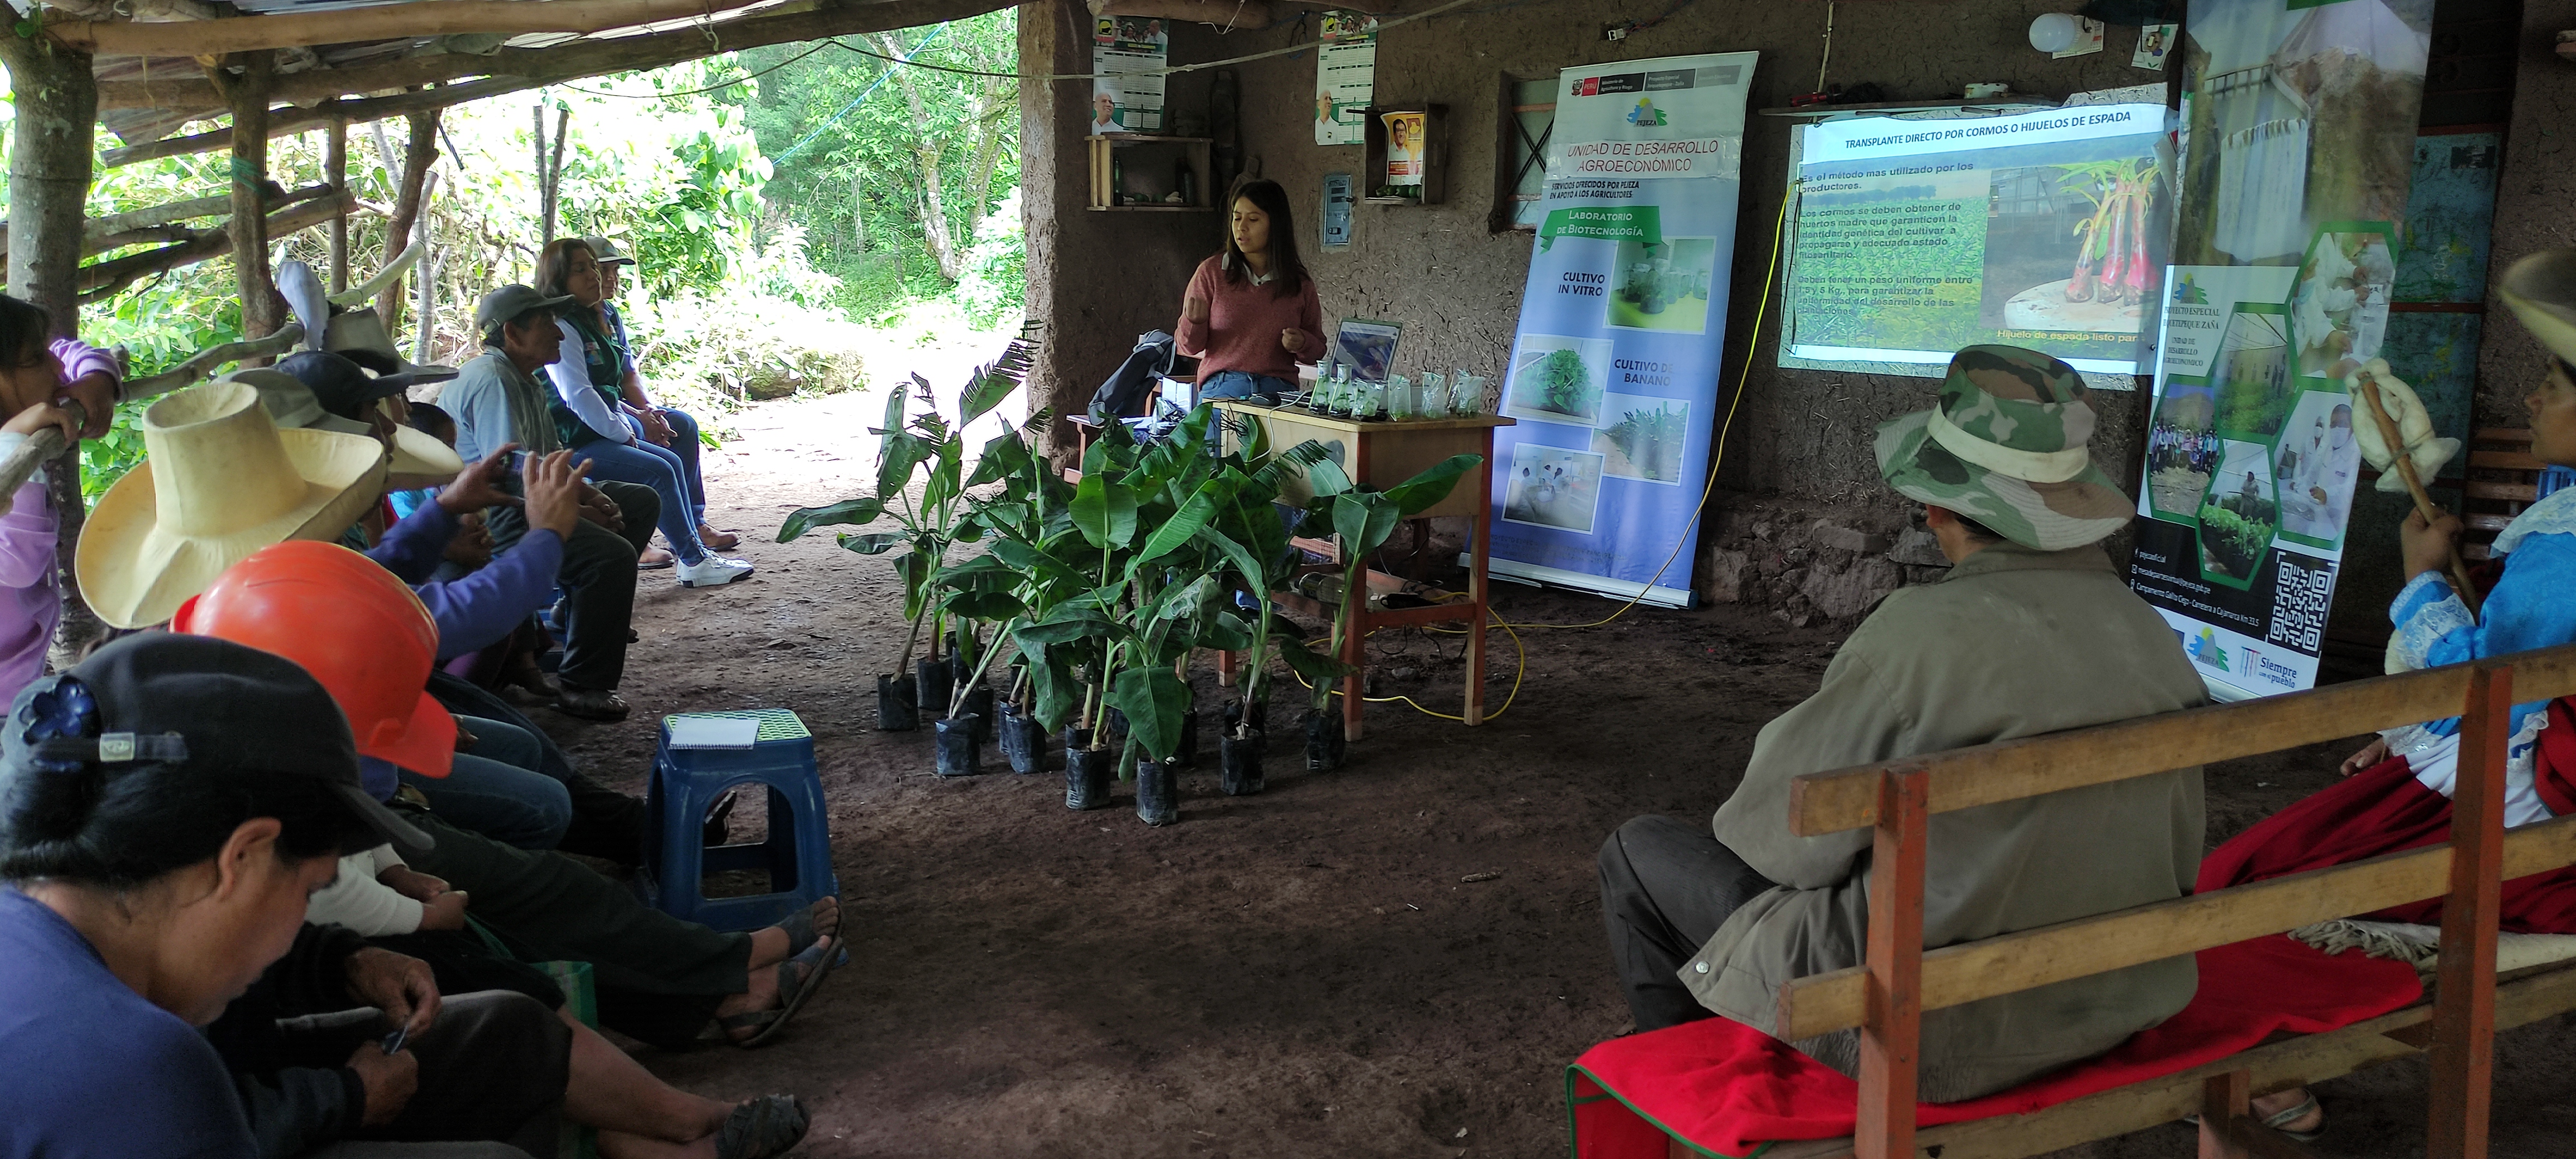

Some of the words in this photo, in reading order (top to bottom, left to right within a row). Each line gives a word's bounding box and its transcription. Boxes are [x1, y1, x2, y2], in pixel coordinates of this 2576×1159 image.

[1846, 135, 1903, 148] TRANSPLANTE
[1905, 132, 1943, 143] DIRECTO
[1945, 129, 1964, 139] POR
[1967, 125, 2008, 137] CORMOS
[2011, 124, 2018, 133] O
[2021, 118, 2068, 132] HIJUELOS
[2071, 116, 2086, 127] DE
[2089, 111, 2131, 125] ESPADA
[1568, 143, 1608, 157] UNIDAD
[1612, 143, 1632, 155] DE
[1635, 140, 1718, 155] DESARROLLO
[1577, 157, 1691, 172] AGROECONÓMICO
[1816, 173, 1826, 181] el
[1829, 171, 1863, 179] método
[1890, 165, 1933, 175] utilizado
[1936, 165, 1954, 174] por
[1552, 182, 1575, 190] SERVICIOS
[1557, 191, 1574, 199] APOYO
[1872, 206, 1901, 215] deben
[1905, 204, 1946, 213] obtener
[1891, 216, 1945, 226] garanticen
[1799, 230, 1842, 238] identidad
[1844, 228, 1884, 239] genética
[1906, 227, 1945, 235] cultivar
[1799, 241, 1851, 250] propagarse
[1862, 238, 1910, 247] adecuado
[1563, 272, 1605, 284] CULTIVO
[1558, 284, 1569, 294] IN
[1573, 285, 1603, 296] VITRO
[1872, 287, 1922, 296] garantizar
[1797, 296, 1851, 305] uniformidad
[1871, 298, 1921, 306] desarrollo
[2189, 308, 2220, 316] ESPECIAL
[2201, 320, 2219, 329] ZAÑA
[1997, 330, 2031, 340] Hijuelo
[2050, 333, 2089, 342] espada
[1614, 359, 1658, 372] CULTIVO
[1661, 363, 1674, 373] DE
[1623, 373, 1671, 386] BANANO
[2198, 653, 2219, 666] PEJEZA
[2260, 658, 2297, 679] Siempre
[2271, 674, 2295, 688] pueblo
